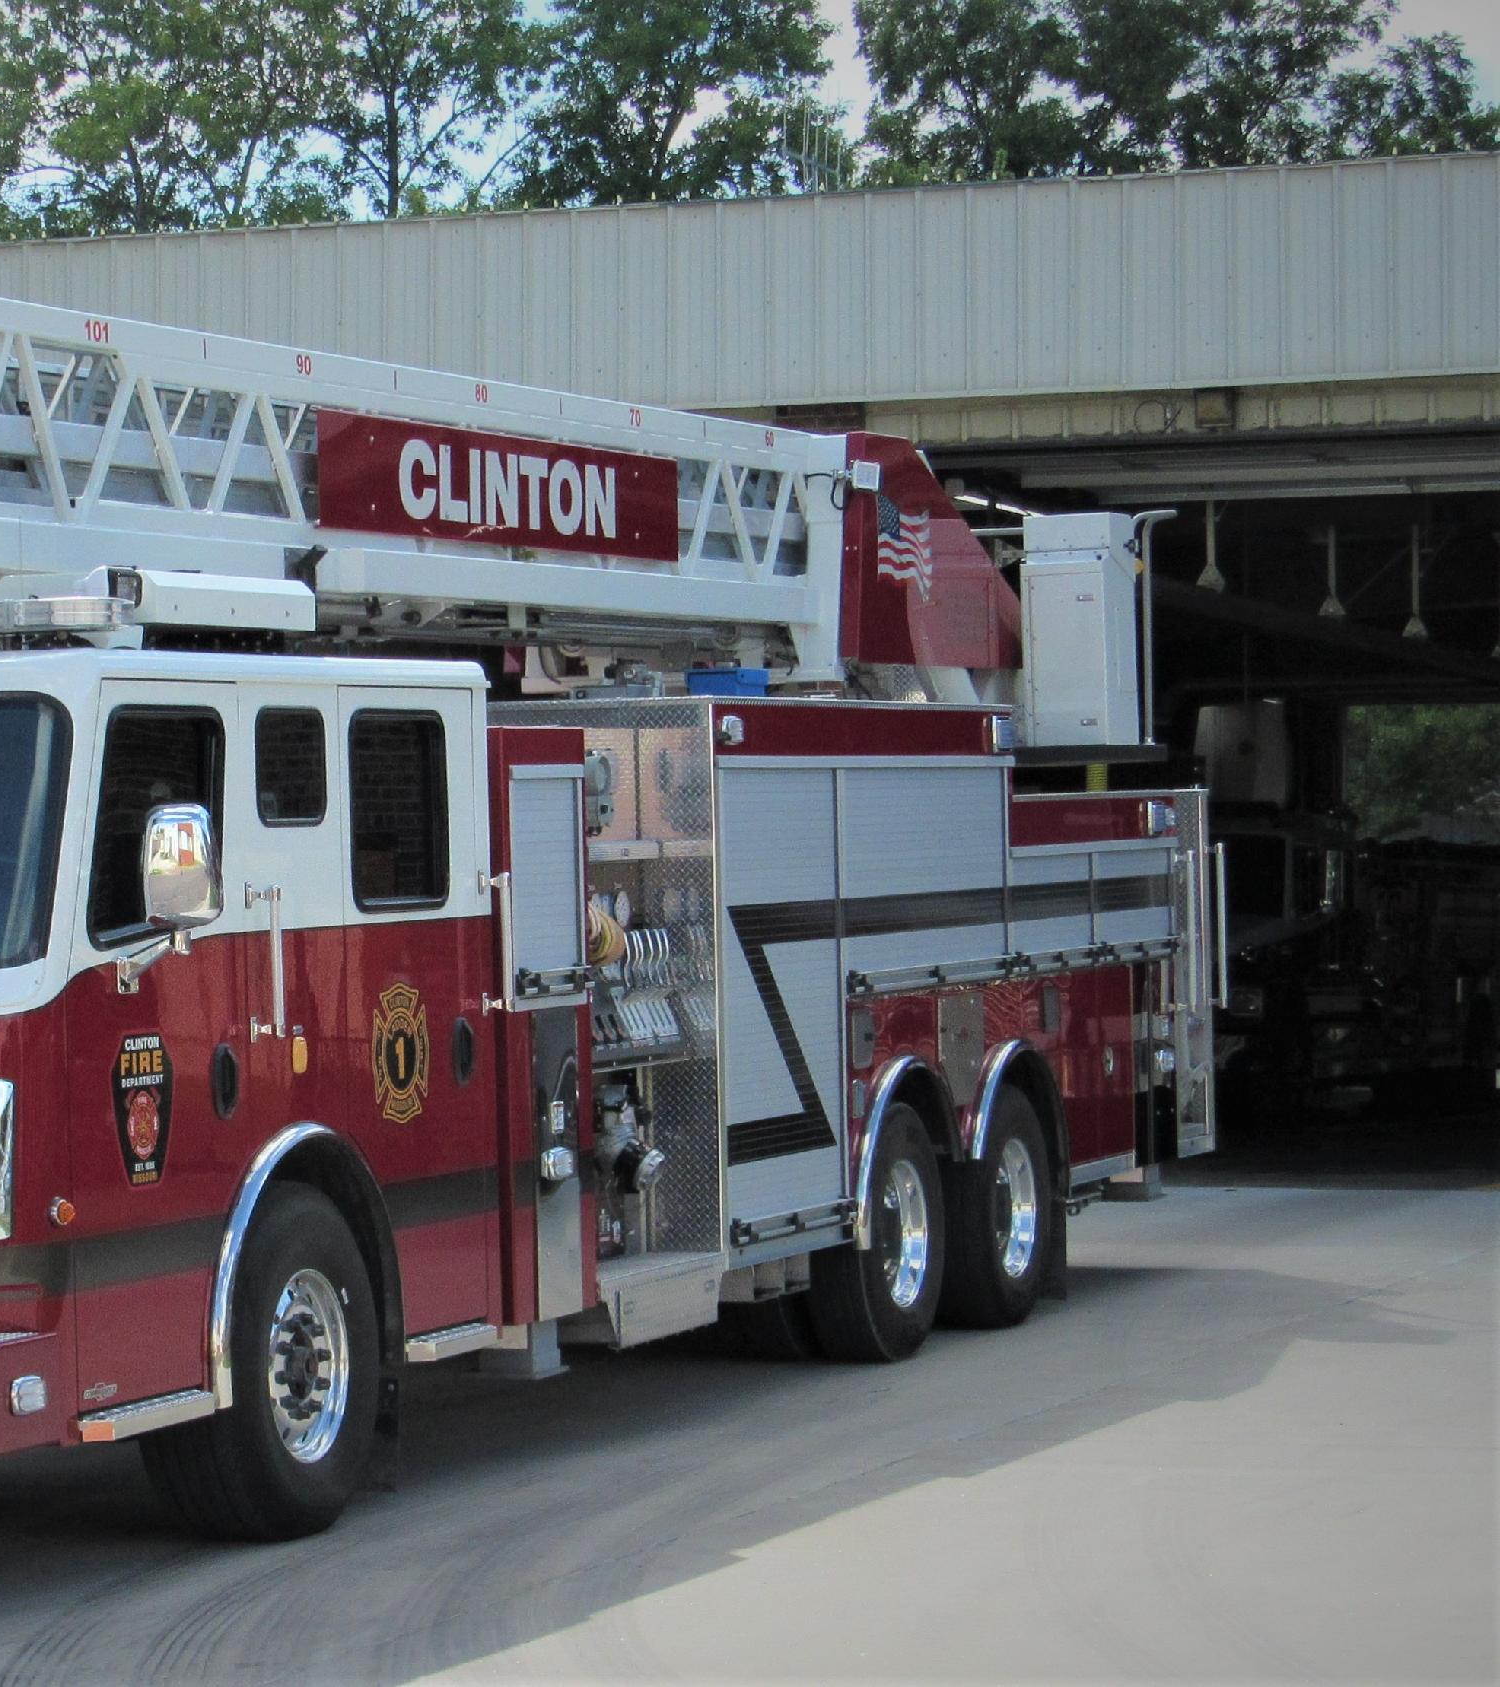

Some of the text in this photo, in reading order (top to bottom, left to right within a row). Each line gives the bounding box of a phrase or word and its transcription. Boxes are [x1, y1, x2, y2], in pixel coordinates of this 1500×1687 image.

[85, 319, 109, 343] 101
[296, 354, 312, 375] 90
[475, 383, 488, 403] 80
[629, 408, 641, 426] 70
[764, 430, 775, 447] 60
[398, 438, 618, 539] CLINTON
[124, 1036, 160, 1051] CLINTON
[120, 1050, 163, 1076] FIRE
[394, 1036, 406, 1080] 1
[121, 1074, 164, 1088] DEPARTMENT
